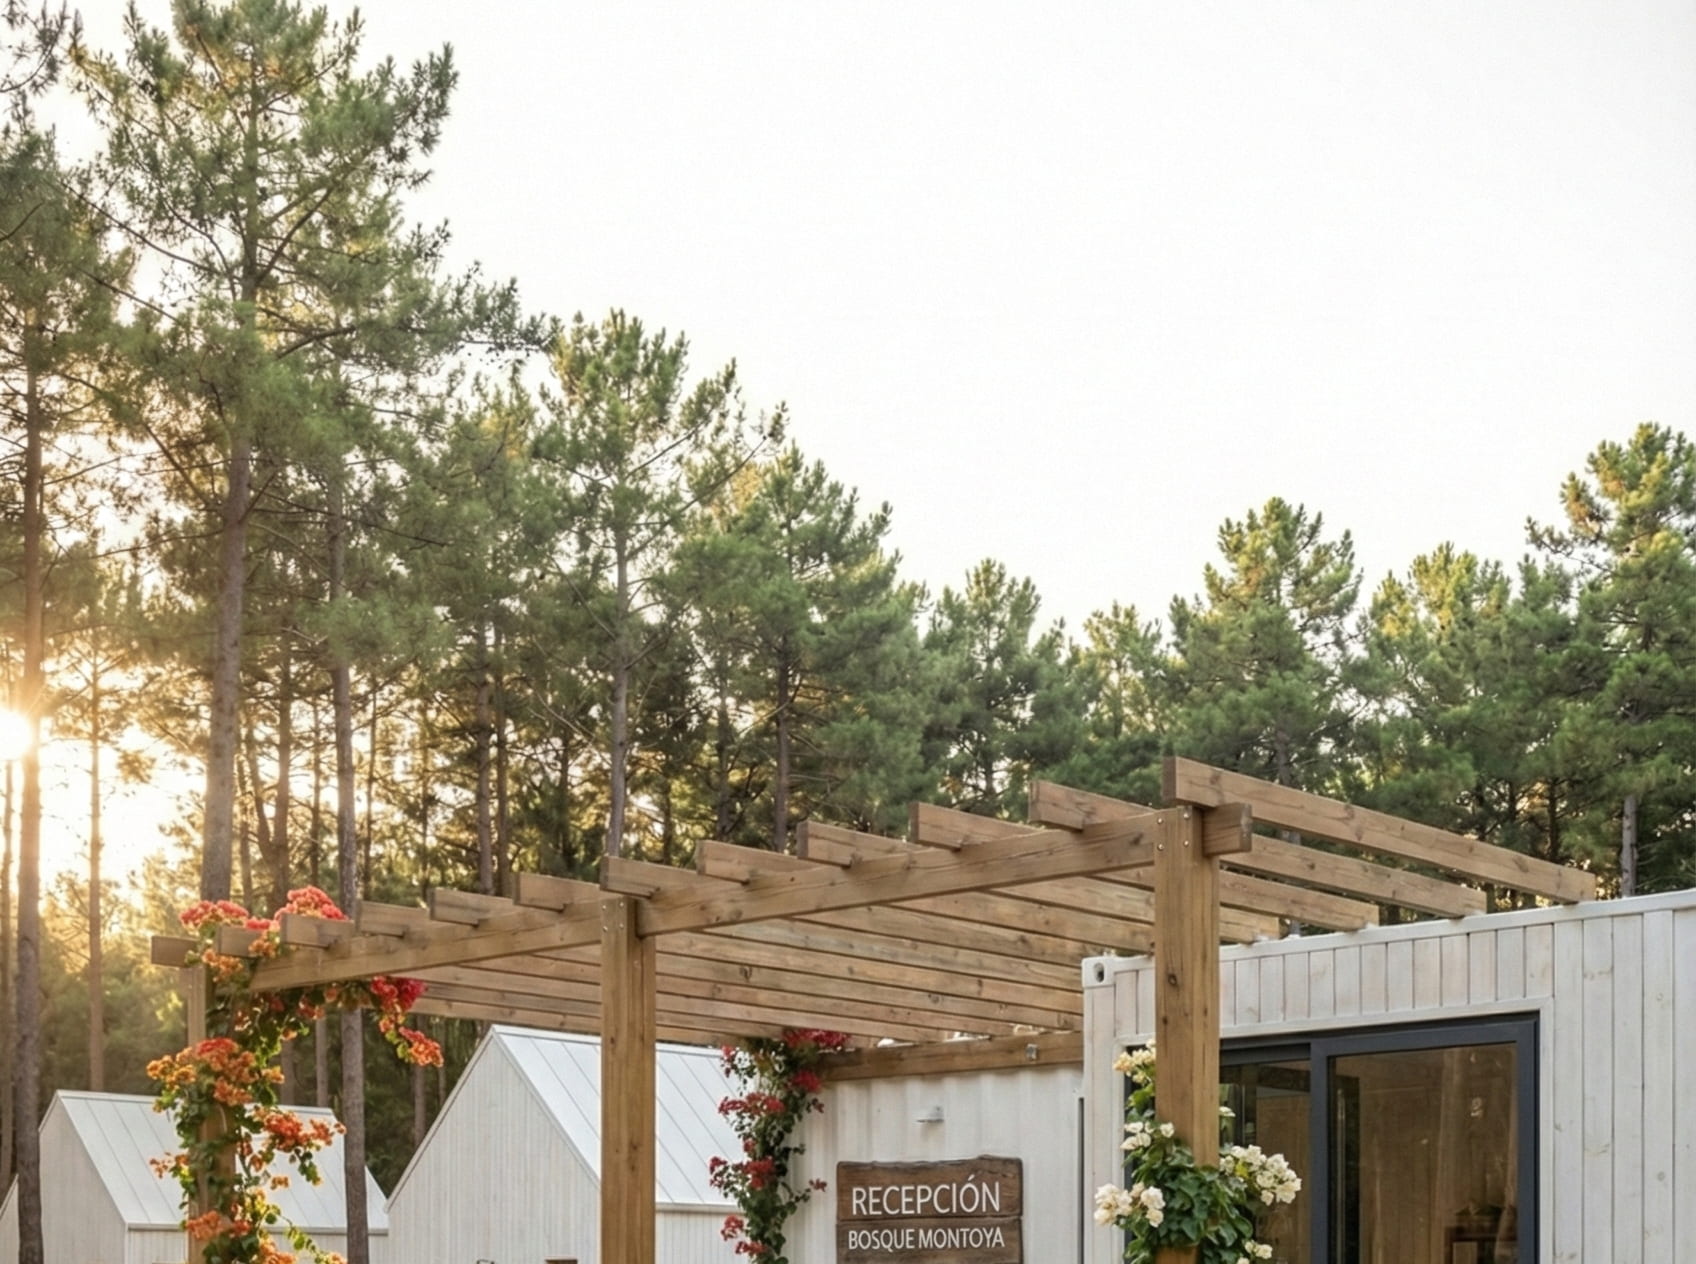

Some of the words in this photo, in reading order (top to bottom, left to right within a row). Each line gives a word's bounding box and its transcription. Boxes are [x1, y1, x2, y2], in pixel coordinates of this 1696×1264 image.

[852, 1174, 1000, 1215] RECEPCIÓN
[849, 1229, 915, 1252] BOSQUE
[919, 1227, 1005, 1249] MONTOYA
